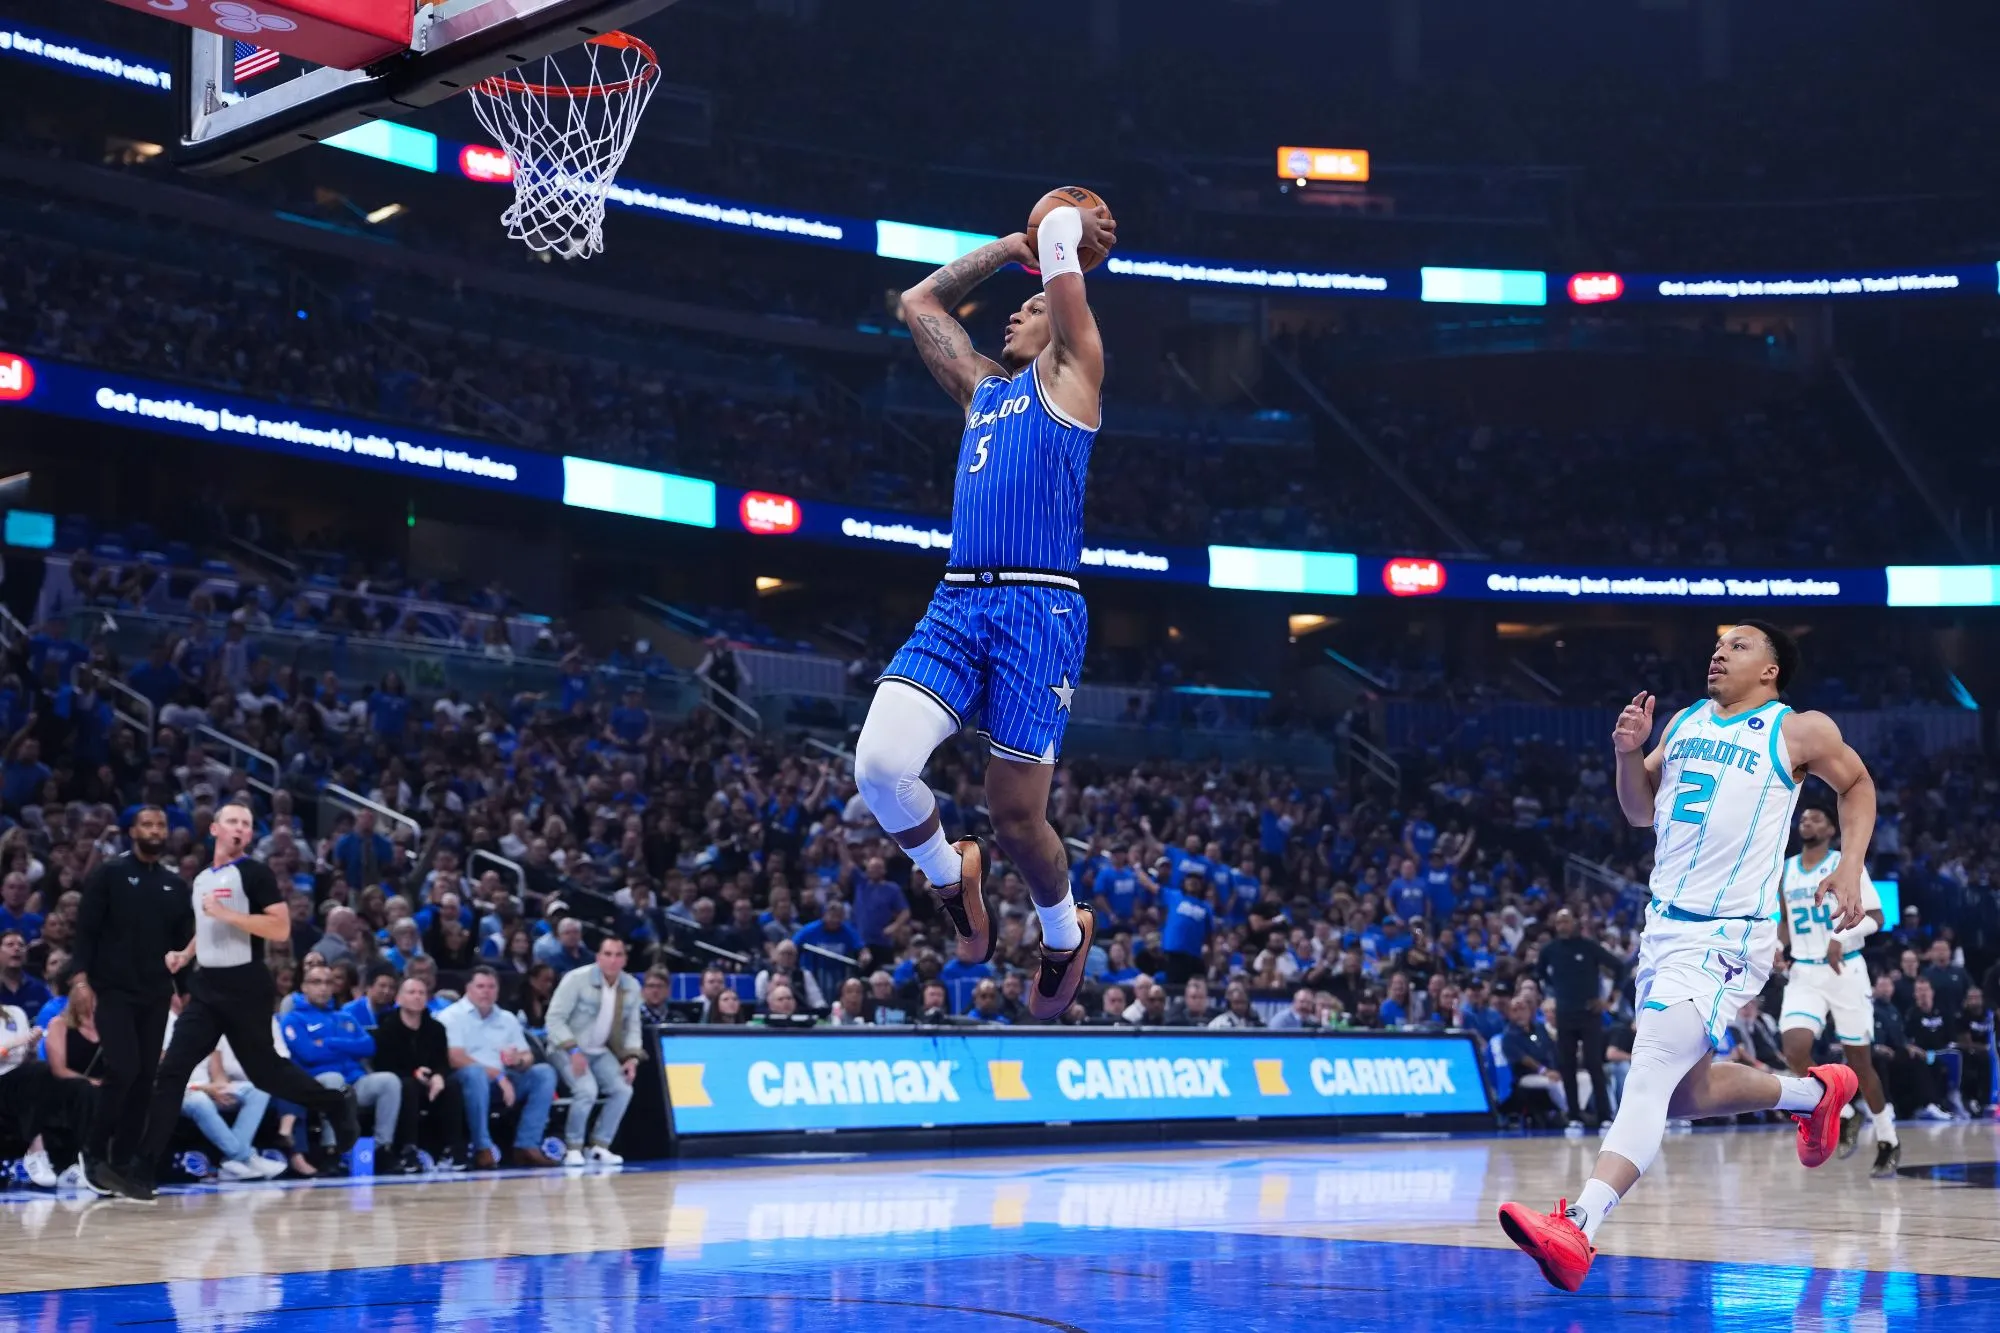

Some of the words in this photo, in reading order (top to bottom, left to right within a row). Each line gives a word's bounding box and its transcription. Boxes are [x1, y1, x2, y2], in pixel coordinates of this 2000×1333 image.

[139, 399, 219, 431] nothing
[221, 409, 257, 434] but
[352, 435, 395, 459] with
[969, 434, 992, 473] 5
[1668, 737, 1761, 774] CHARLOTTE
[1671, 770, 1717, 825] 2
[1791, 904, 1834, 935] 24
